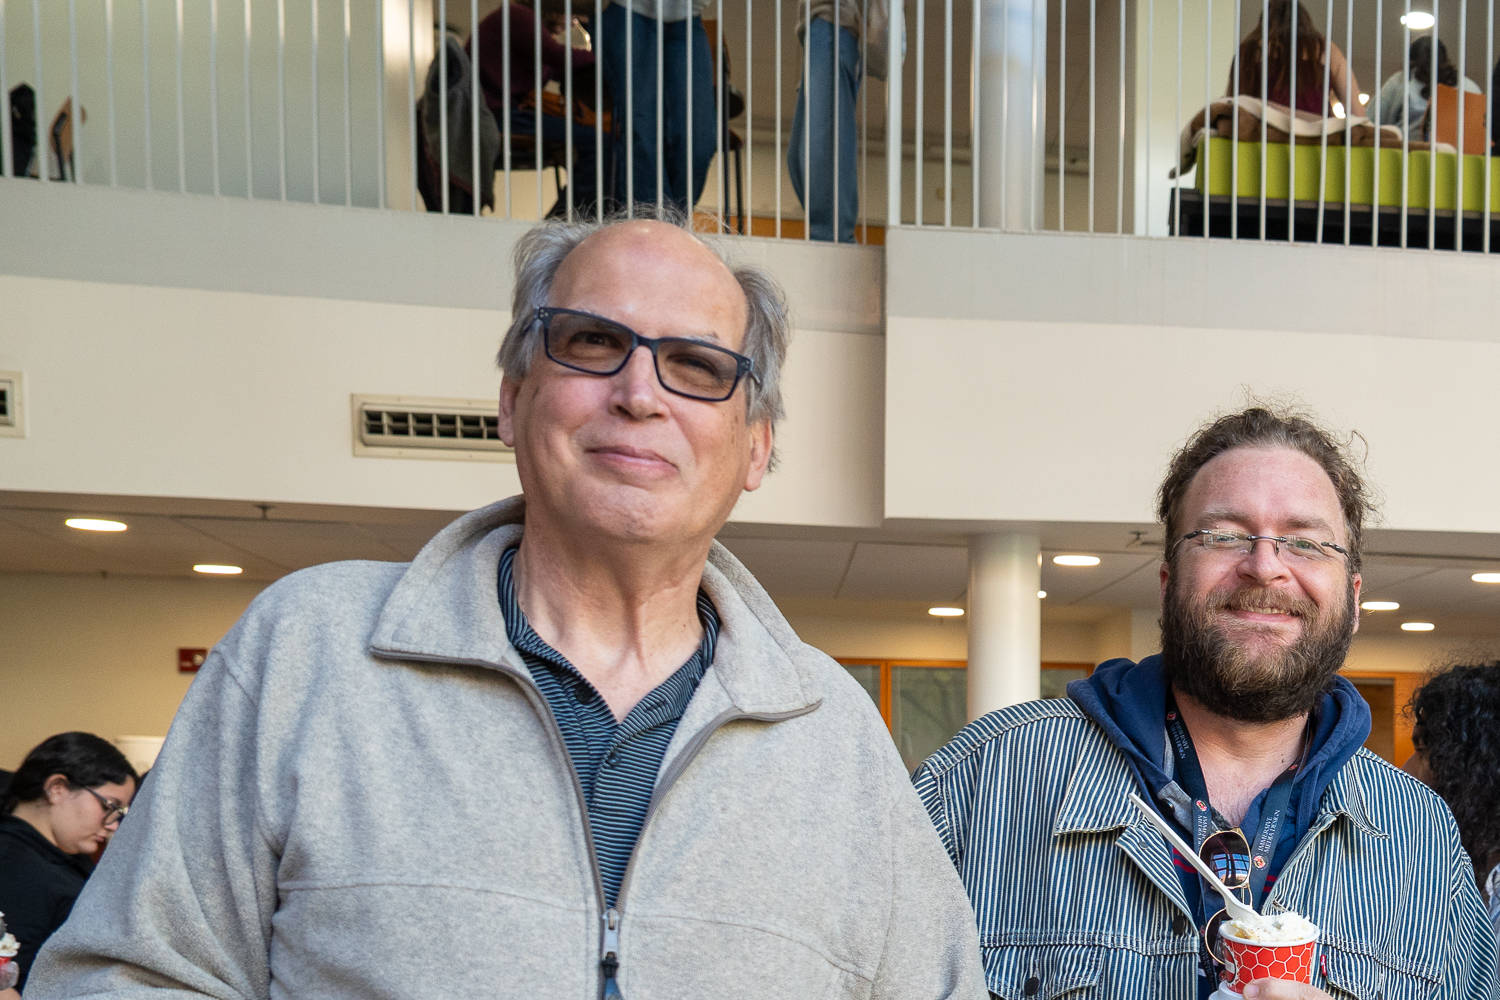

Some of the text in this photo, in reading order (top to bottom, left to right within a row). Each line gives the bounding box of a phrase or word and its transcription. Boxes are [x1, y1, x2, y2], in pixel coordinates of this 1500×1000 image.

[1258, 816, 1272, 851] IMMERSIVE
[1264, 809, 1280, 853] MEDIA DESIGN
